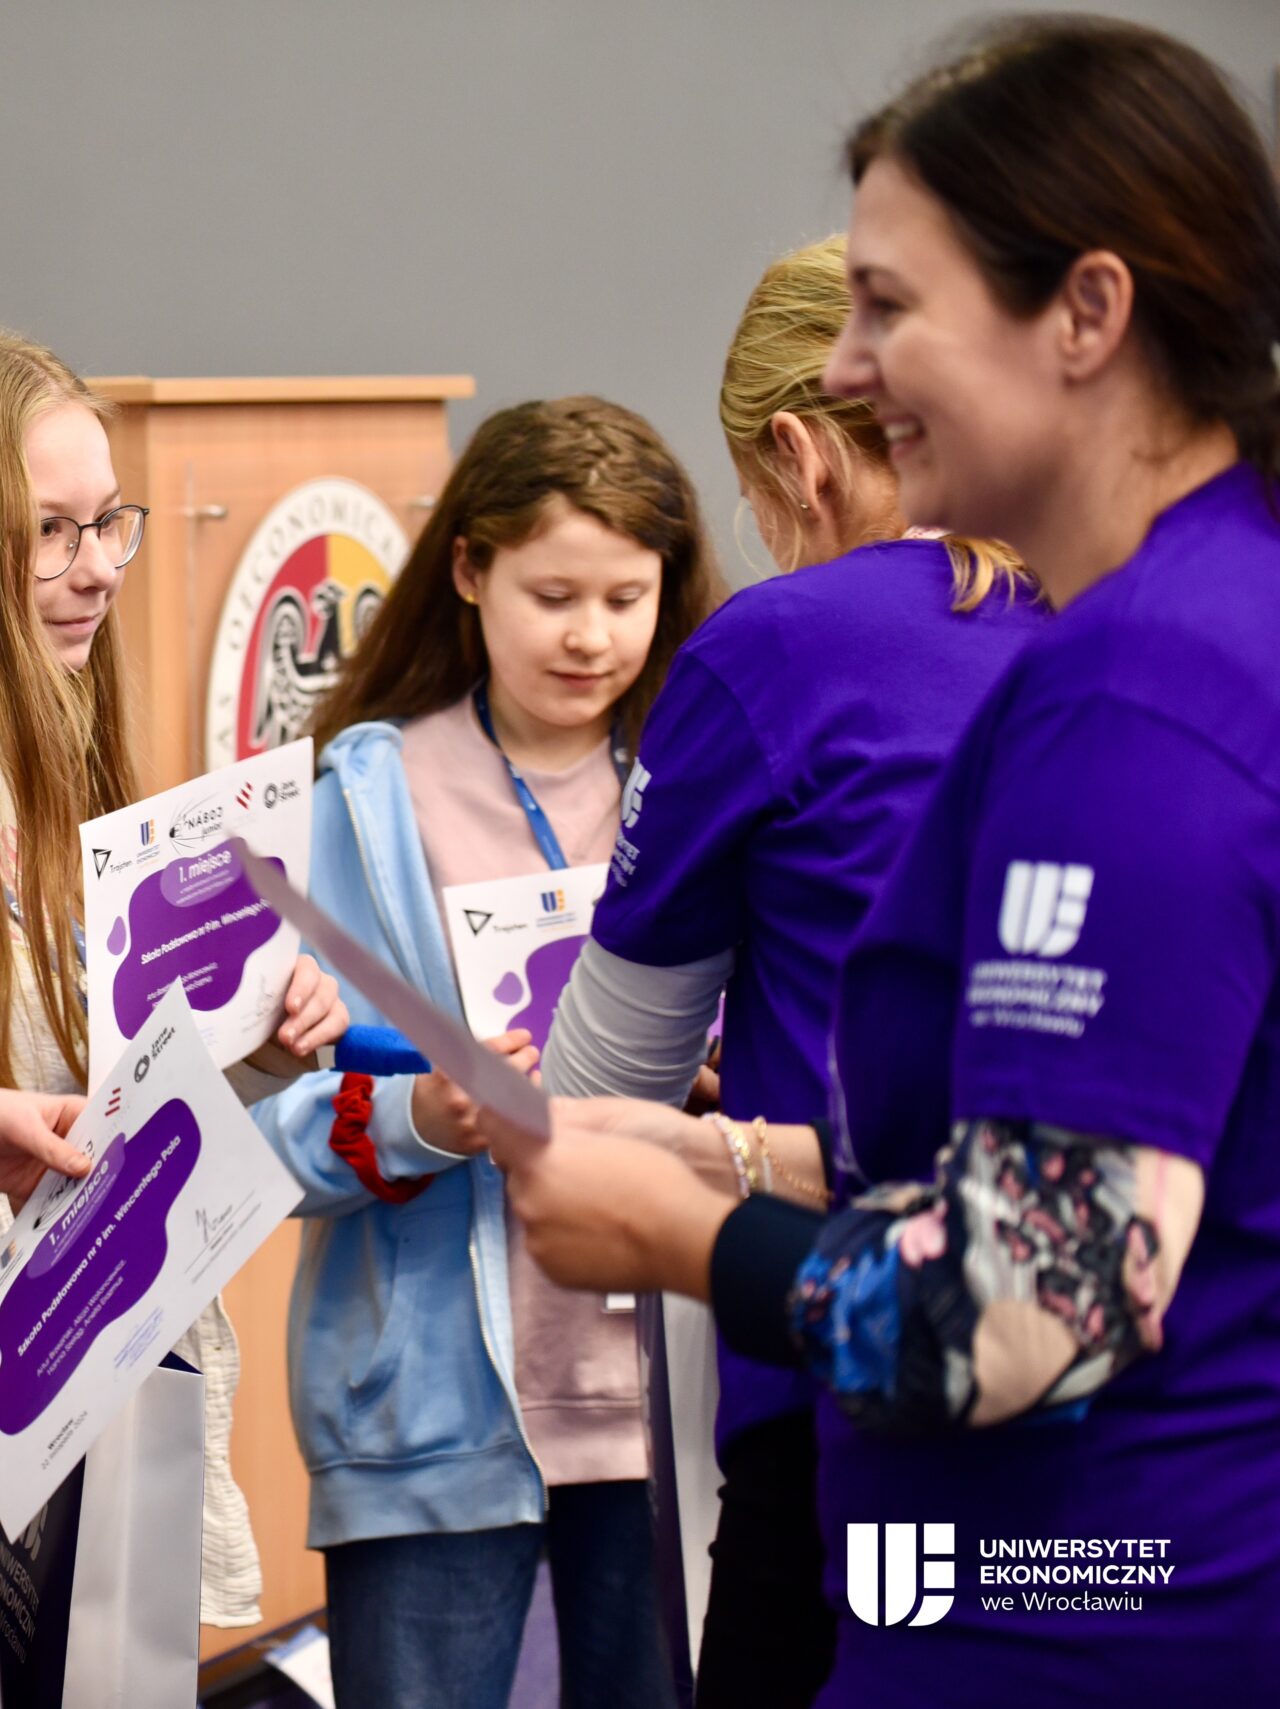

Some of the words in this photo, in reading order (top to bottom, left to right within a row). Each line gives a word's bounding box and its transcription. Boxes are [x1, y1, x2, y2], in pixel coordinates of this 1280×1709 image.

[188, 850, 232, 879] miejsce
[151, 1027, 169, 1051] Jane
[151, 1027, 177, 1061] Street
[48, 1226, 60, 1246] 1.
[59, 1157, 111, 1233] miejsce
[16, 1317, 42, 1358] Szkoła
[40, 1255, 89, 1324] Podstawowa
[101, 1217, 116, 1242] im.
[113, 1156, 163, 1226] Wincentego
[160, 1131, 181, 1162] Pola
